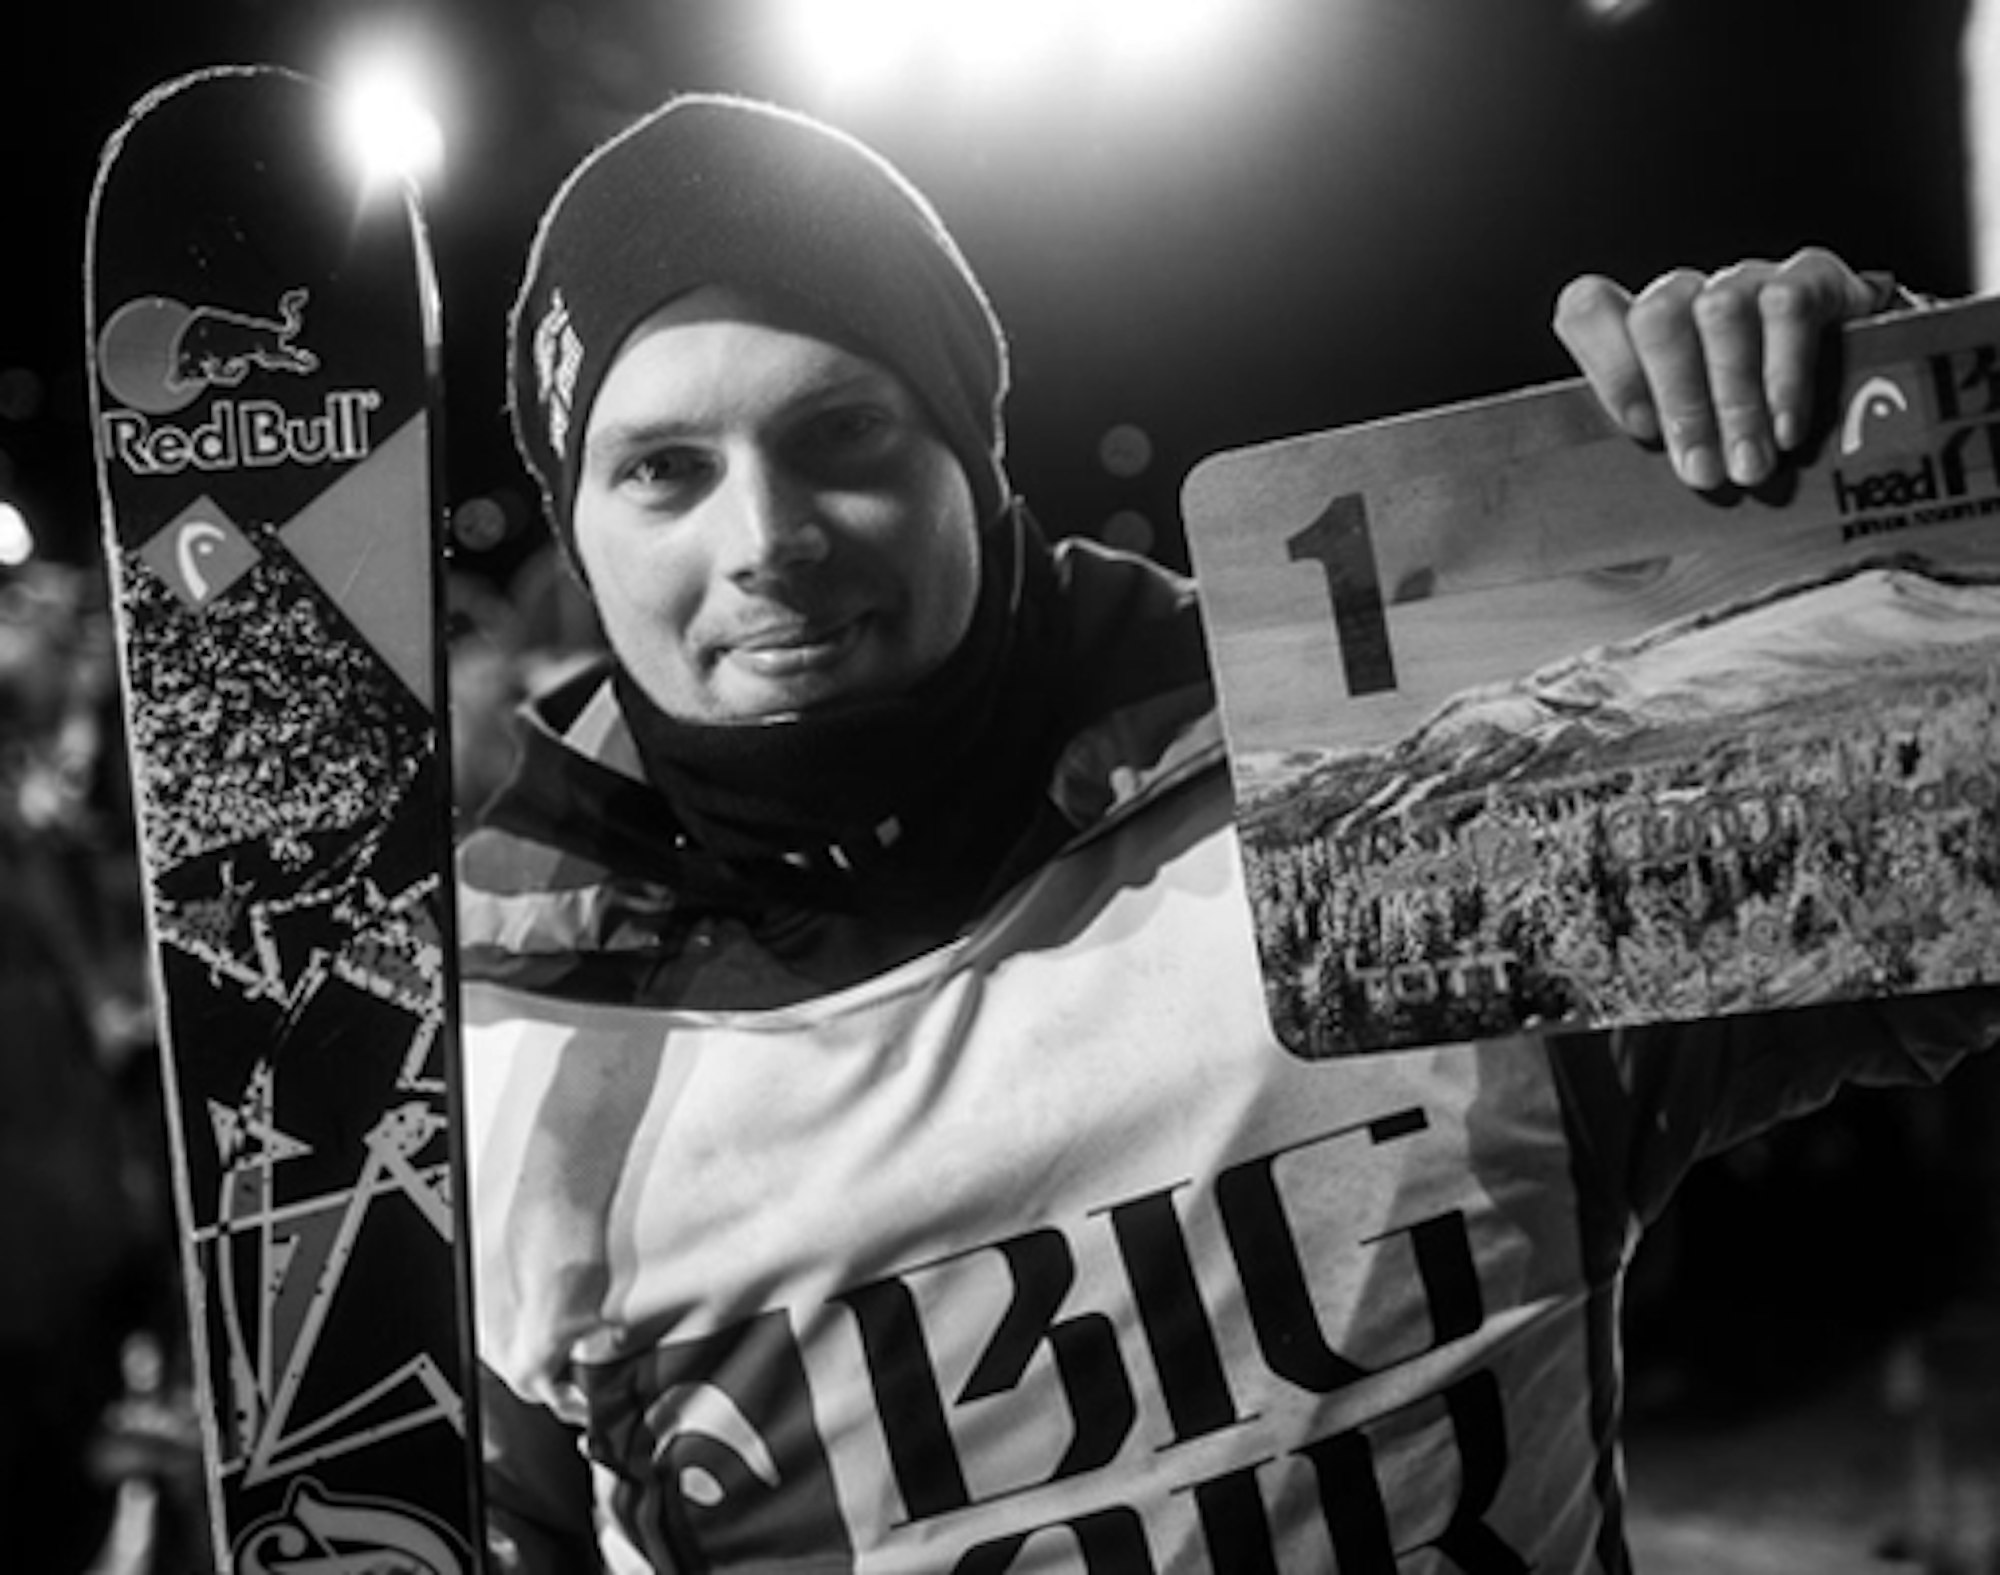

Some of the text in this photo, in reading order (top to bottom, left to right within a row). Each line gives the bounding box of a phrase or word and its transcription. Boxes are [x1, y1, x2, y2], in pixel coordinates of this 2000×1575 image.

[1833, 453, 1938, 515] head
[1286, 491, 1397, 696] 1
[827, 1106, 1484, 1528] BIG
